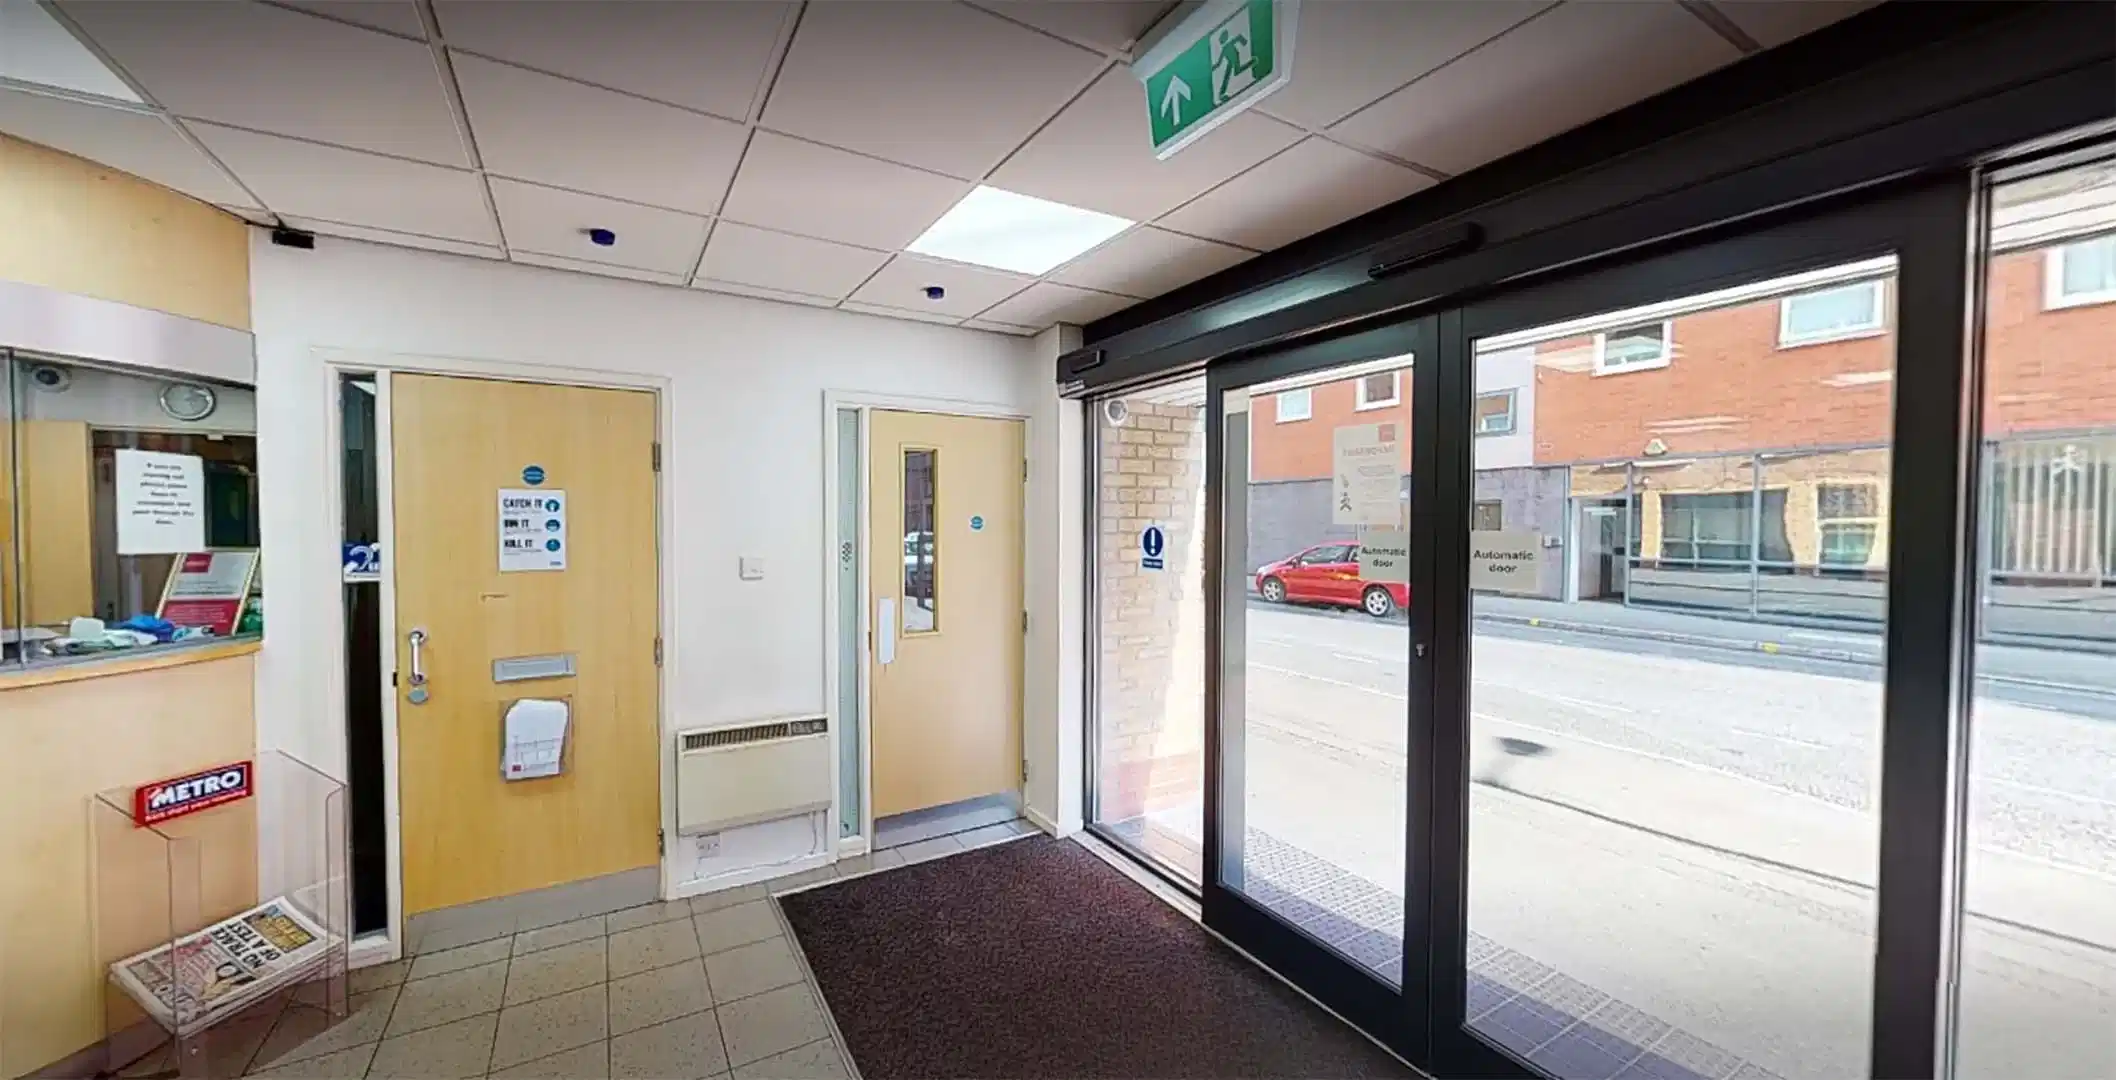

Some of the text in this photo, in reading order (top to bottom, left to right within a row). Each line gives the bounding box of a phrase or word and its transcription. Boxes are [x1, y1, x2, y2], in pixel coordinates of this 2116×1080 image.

[503, 498, 542, 508] CATCH IT
[521, 519, 529, 528] IT
[525, 539, 533, 548] IT
[1361, 546, 1406, 557] Automatic
[1473, 550, 1533, 561] Automatic
[1372, 558, 1393, 567] door
[1489, 564, 1517, 573] door
[152, 771, 241, 808] METRO
[211, 927, 251, 957] TRACE
[226, 921, 281, 961] OF A TEST
[243, 954, 265, 969] NO
